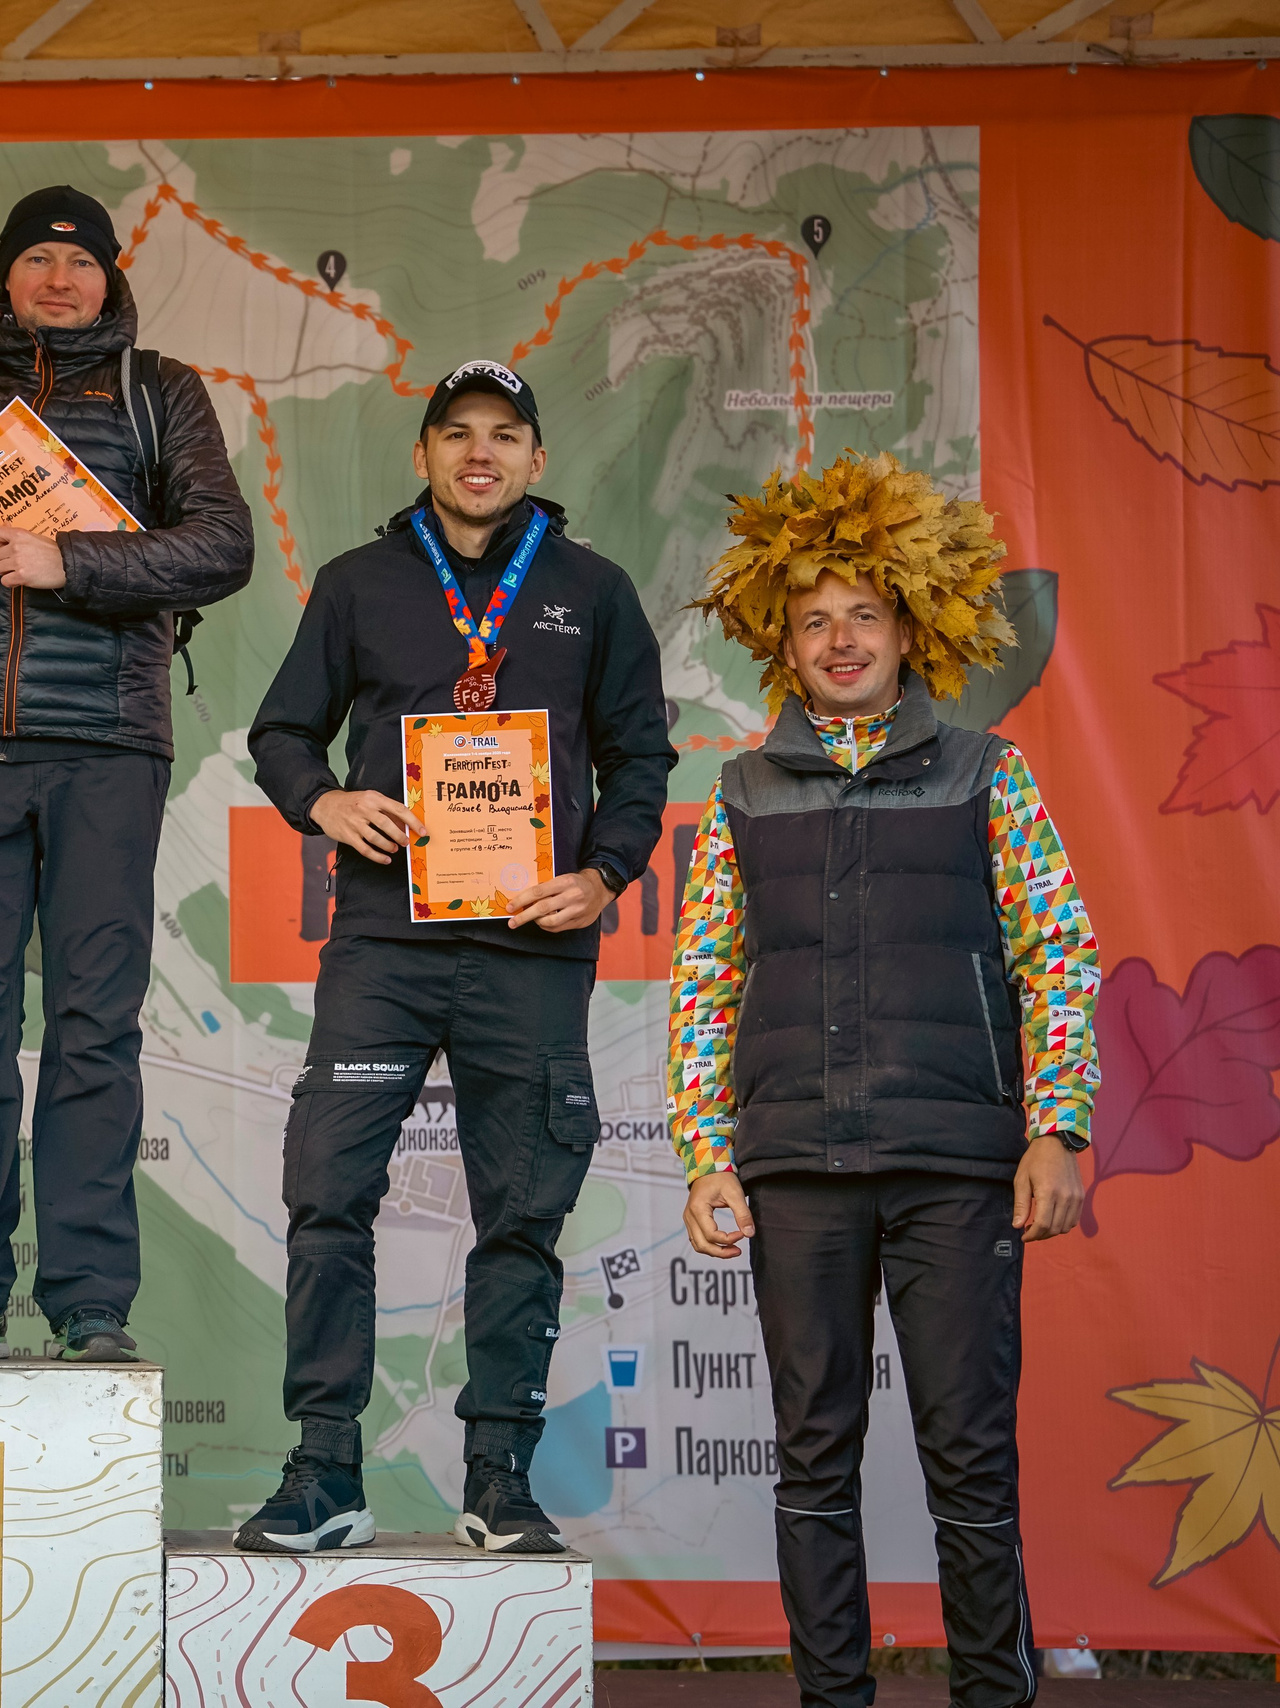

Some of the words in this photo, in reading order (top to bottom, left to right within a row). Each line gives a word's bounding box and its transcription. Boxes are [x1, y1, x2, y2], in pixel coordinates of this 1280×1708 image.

[813, 221, 824, 244] 5
[326, 255, 336, 278] 4
[452, 367, 516, 389] CANADA
[827, 391, 892, 409] пещера
[462, 689, 479, 704] Fe
[455, 736, 498, 747] O-TRAIL
[436, 780, 521, 802] ГРАМОТА
[492, 833, 498, 841] 9
[334, 1063, 371, 1071] BLACK
[673, 1341, 757, 1399] Пункт
[289, 1584, 444, 1708] 3
